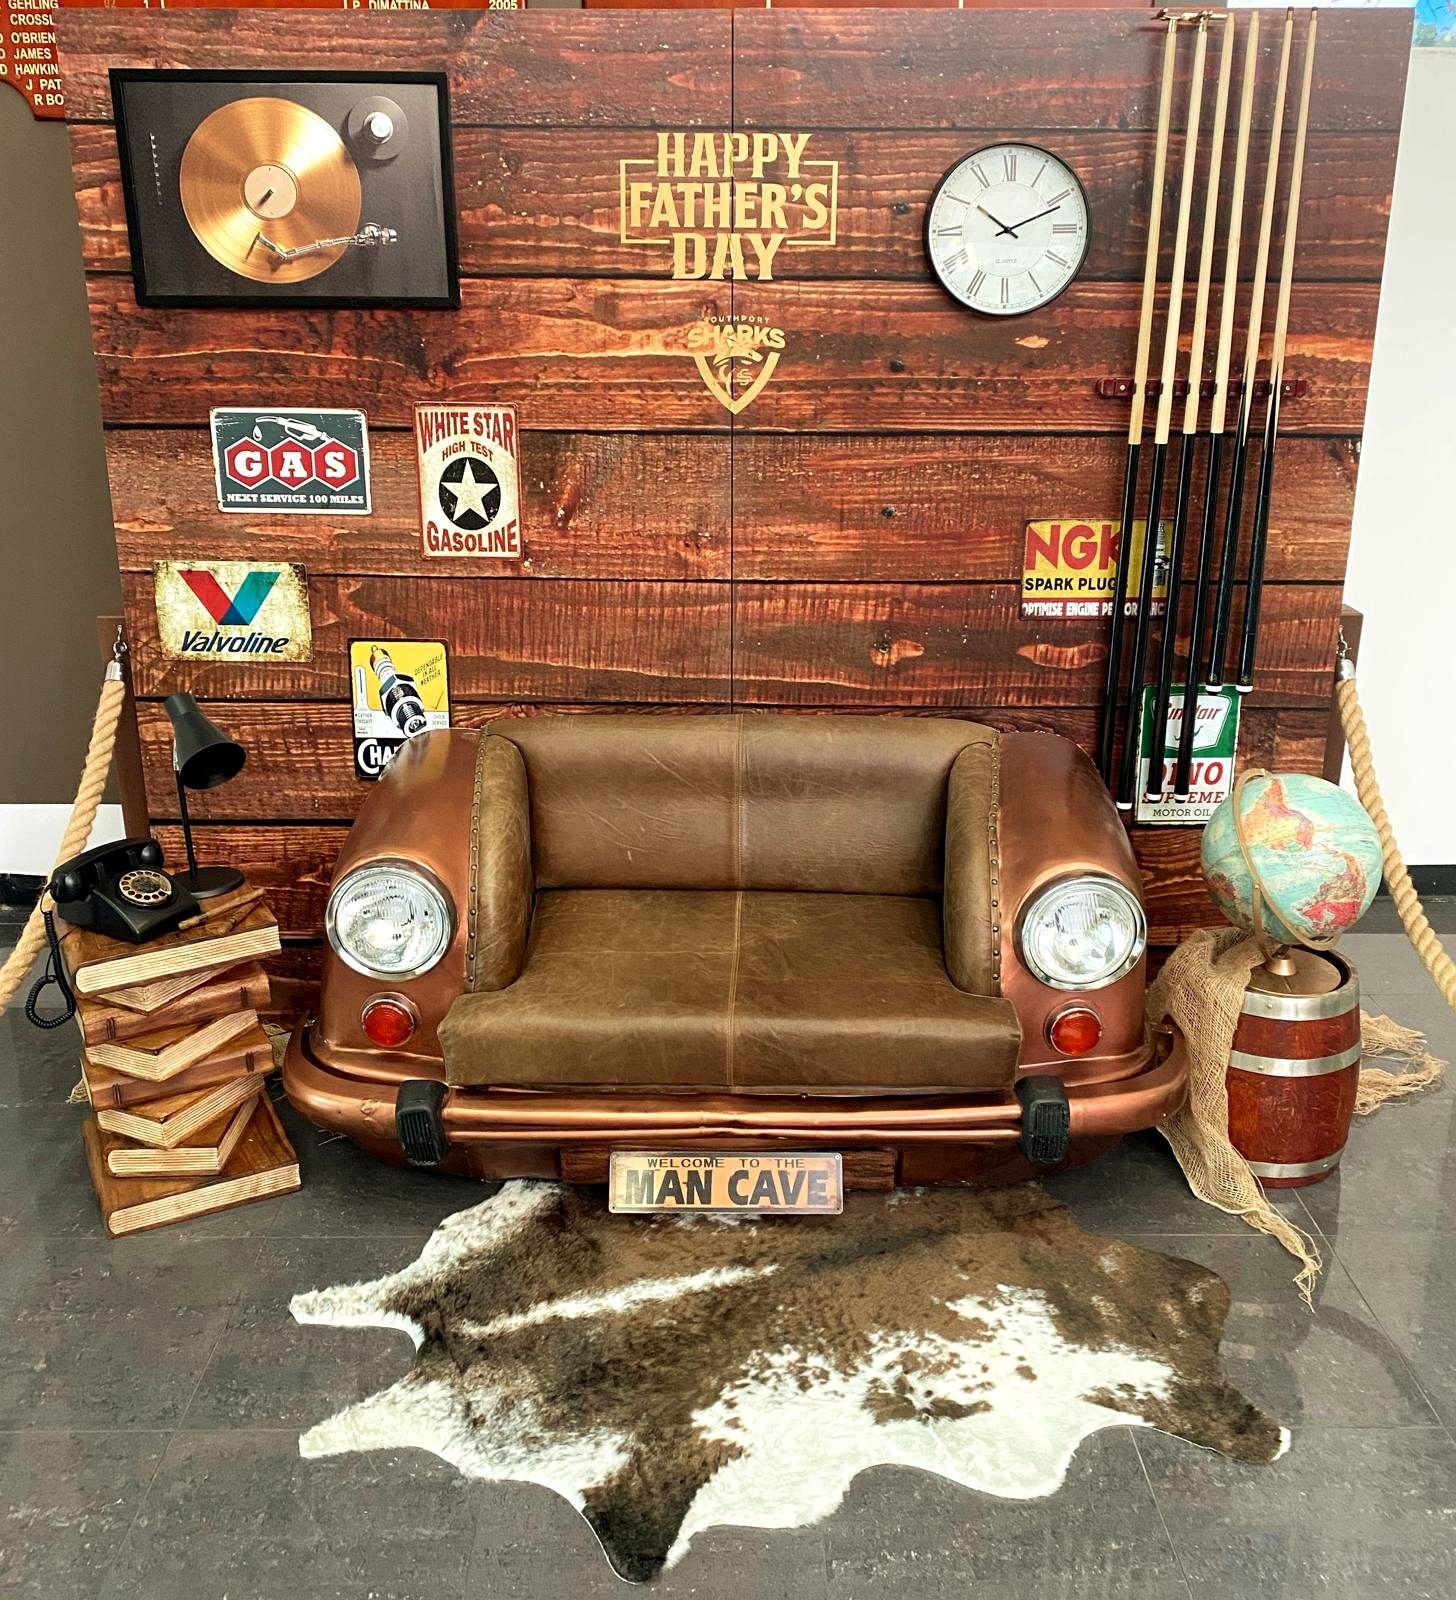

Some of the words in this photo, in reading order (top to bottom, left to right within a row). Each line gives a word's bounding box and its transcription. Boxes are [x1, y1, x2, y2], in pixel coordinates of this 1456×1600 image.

[8, 0, 59, 10] GEHLING
[369, 0, 430, 10] DIMATTINA
[489, 0, 518, 10] 2005
[11, 32, 56, 44] O'BRIEN
[14, 48, 52, 60] JAMES
[26, 79, 33, 91] J
[34, 94, 44, 106] R
[656, 132, 813, 179] HAPPY
[630, 182, 828, 229] FATHER'S
[672, 233, 787, 281] DAY
[704, 315, 770, 324] SOUTHPORT
[687, 324, 786, 349] SHARKS
[418, 411, 470, 454] WHITE
[473, 411, 515, 459] STAR
[442, 440, 466, 462] HIGH
[470, 440, 494, 462] TEST
[234, 450, 347, 478] GAS
[226, 493, 259, 503] NEXT
[260, 494, 307, 503] SERVICE
[309, 495, 328, 504] 100
[330, 495, 364, 504] MILES
[427, 518, 518, 553] GASOLINE
[1024, 524, 1122, 570] NGK
[1025, 577, 1073, 591] SPARK
[1022, 602, 1063, 616] OPTIMISE
[1066, 602, 1099, 616] ENGINE
[181, 631, 290, 654] Valvoline
[1152, 808, 1191, 817] MOTOR
[1193, 808, 1212, 817] OIL
[647, 1158, 725, 1168] WELCOME
[739, 1158, 760, 1168] TO
[776, 1158, 805, 1168] THE
[624, 1169, 713, 1206] MAN
[727, 1169, 830, 1206] CAVE
